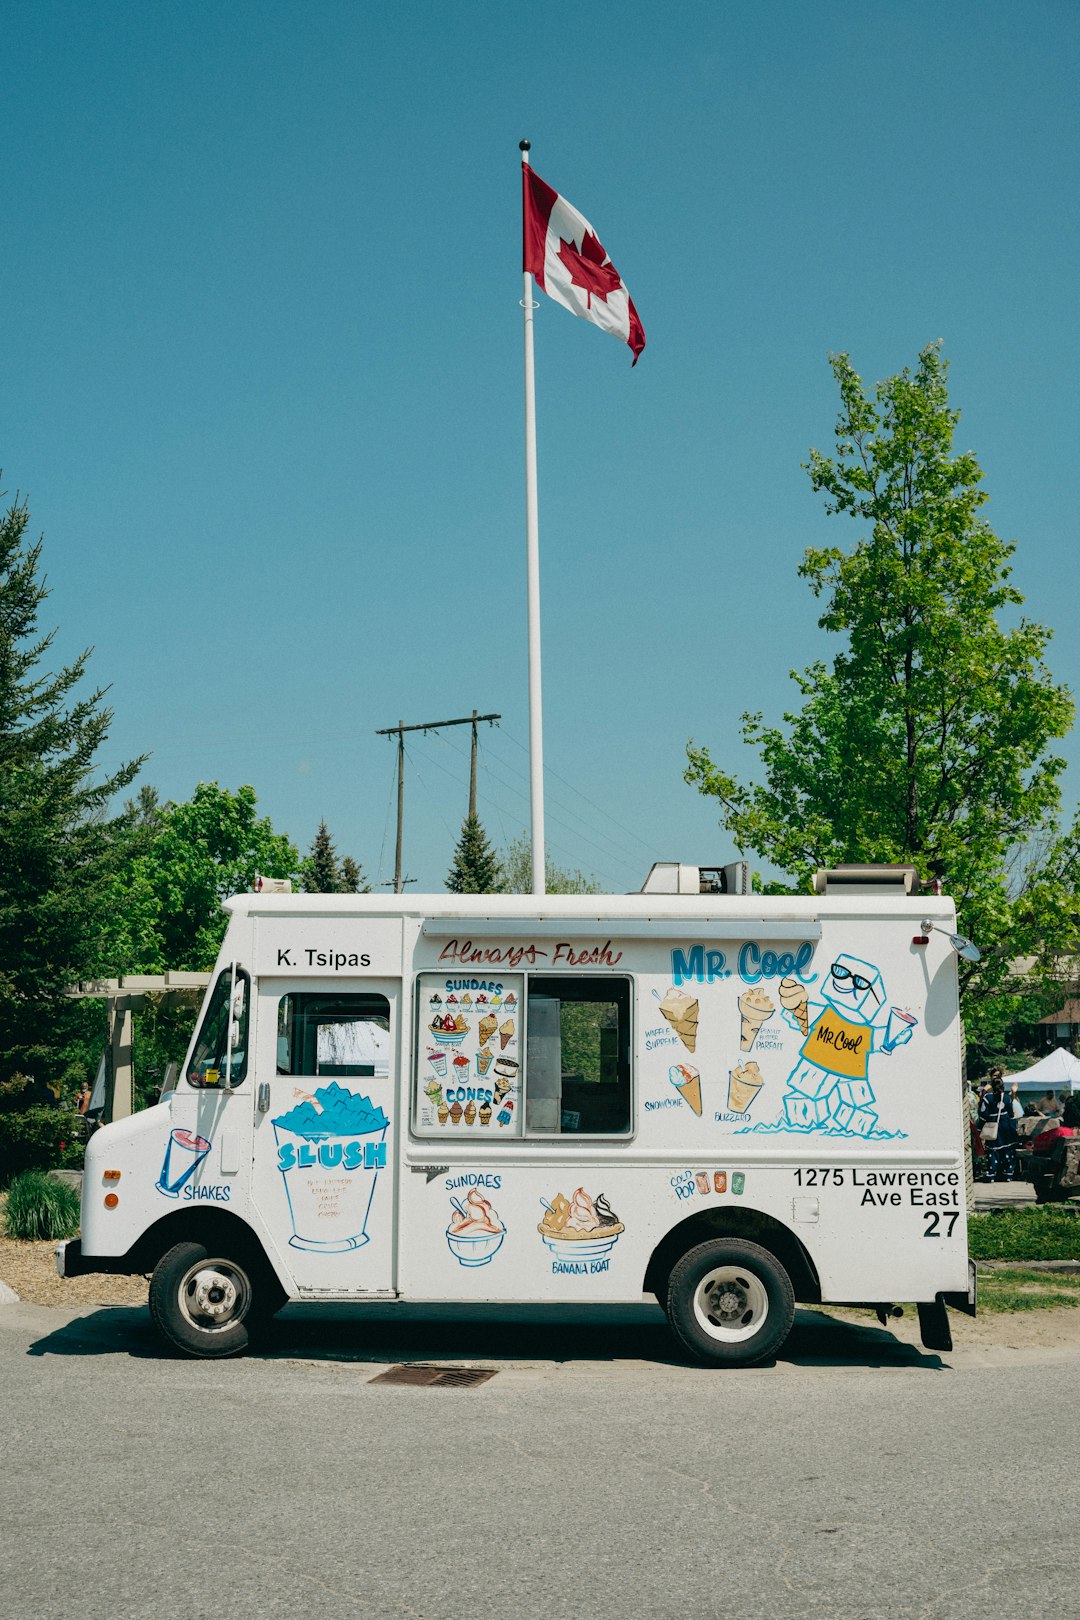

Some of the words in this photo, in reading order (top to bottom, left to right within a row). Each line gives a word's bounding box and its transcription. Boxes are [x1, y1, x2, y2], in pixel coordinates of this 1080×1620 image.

[277, 949, 297, 966] K.
[304, 949, 371, 971] Tsipas
[438, 939, 548, 967] Always
[552, 940, 623, 966] Fresh
[738, 941, 819, 984] Cool
[445, 979, 504, 996] SUNDAES
[645, 1027, 671, 1038] WAFFLE
[646, 1036, 679, 1051] SUPREME
[756, 1040, 784, 1051] PARFAIT
[834, 1030, 863, 1055] Cool
[446, 1086, 493, 1103] CONES
[644, 1097, 684, 1112] SNOWCONE
[714, 1112, 752, 1122] BLIZZARD
[277, 1141, 387, 1172] SLUSH
[445, 1173, 502, 1191] SUNDAES
[670, 1170, 692, 1187] COLD
[793, 1169, 844, 1186] 1275
[852, 1169, 959, 1186] Lawrence
[183, 1185, 231, 1201] SHAKES
[674, 1180, 695, 1201] POP
[860, 1188, 902, 1206] Ave
[910, 1188, 959, 1206] East
[923, 1211, 960, 1237] 27
[552, 1261, 588, 1274] BANANA
[590, 1258, 611, 1274] BOAT
